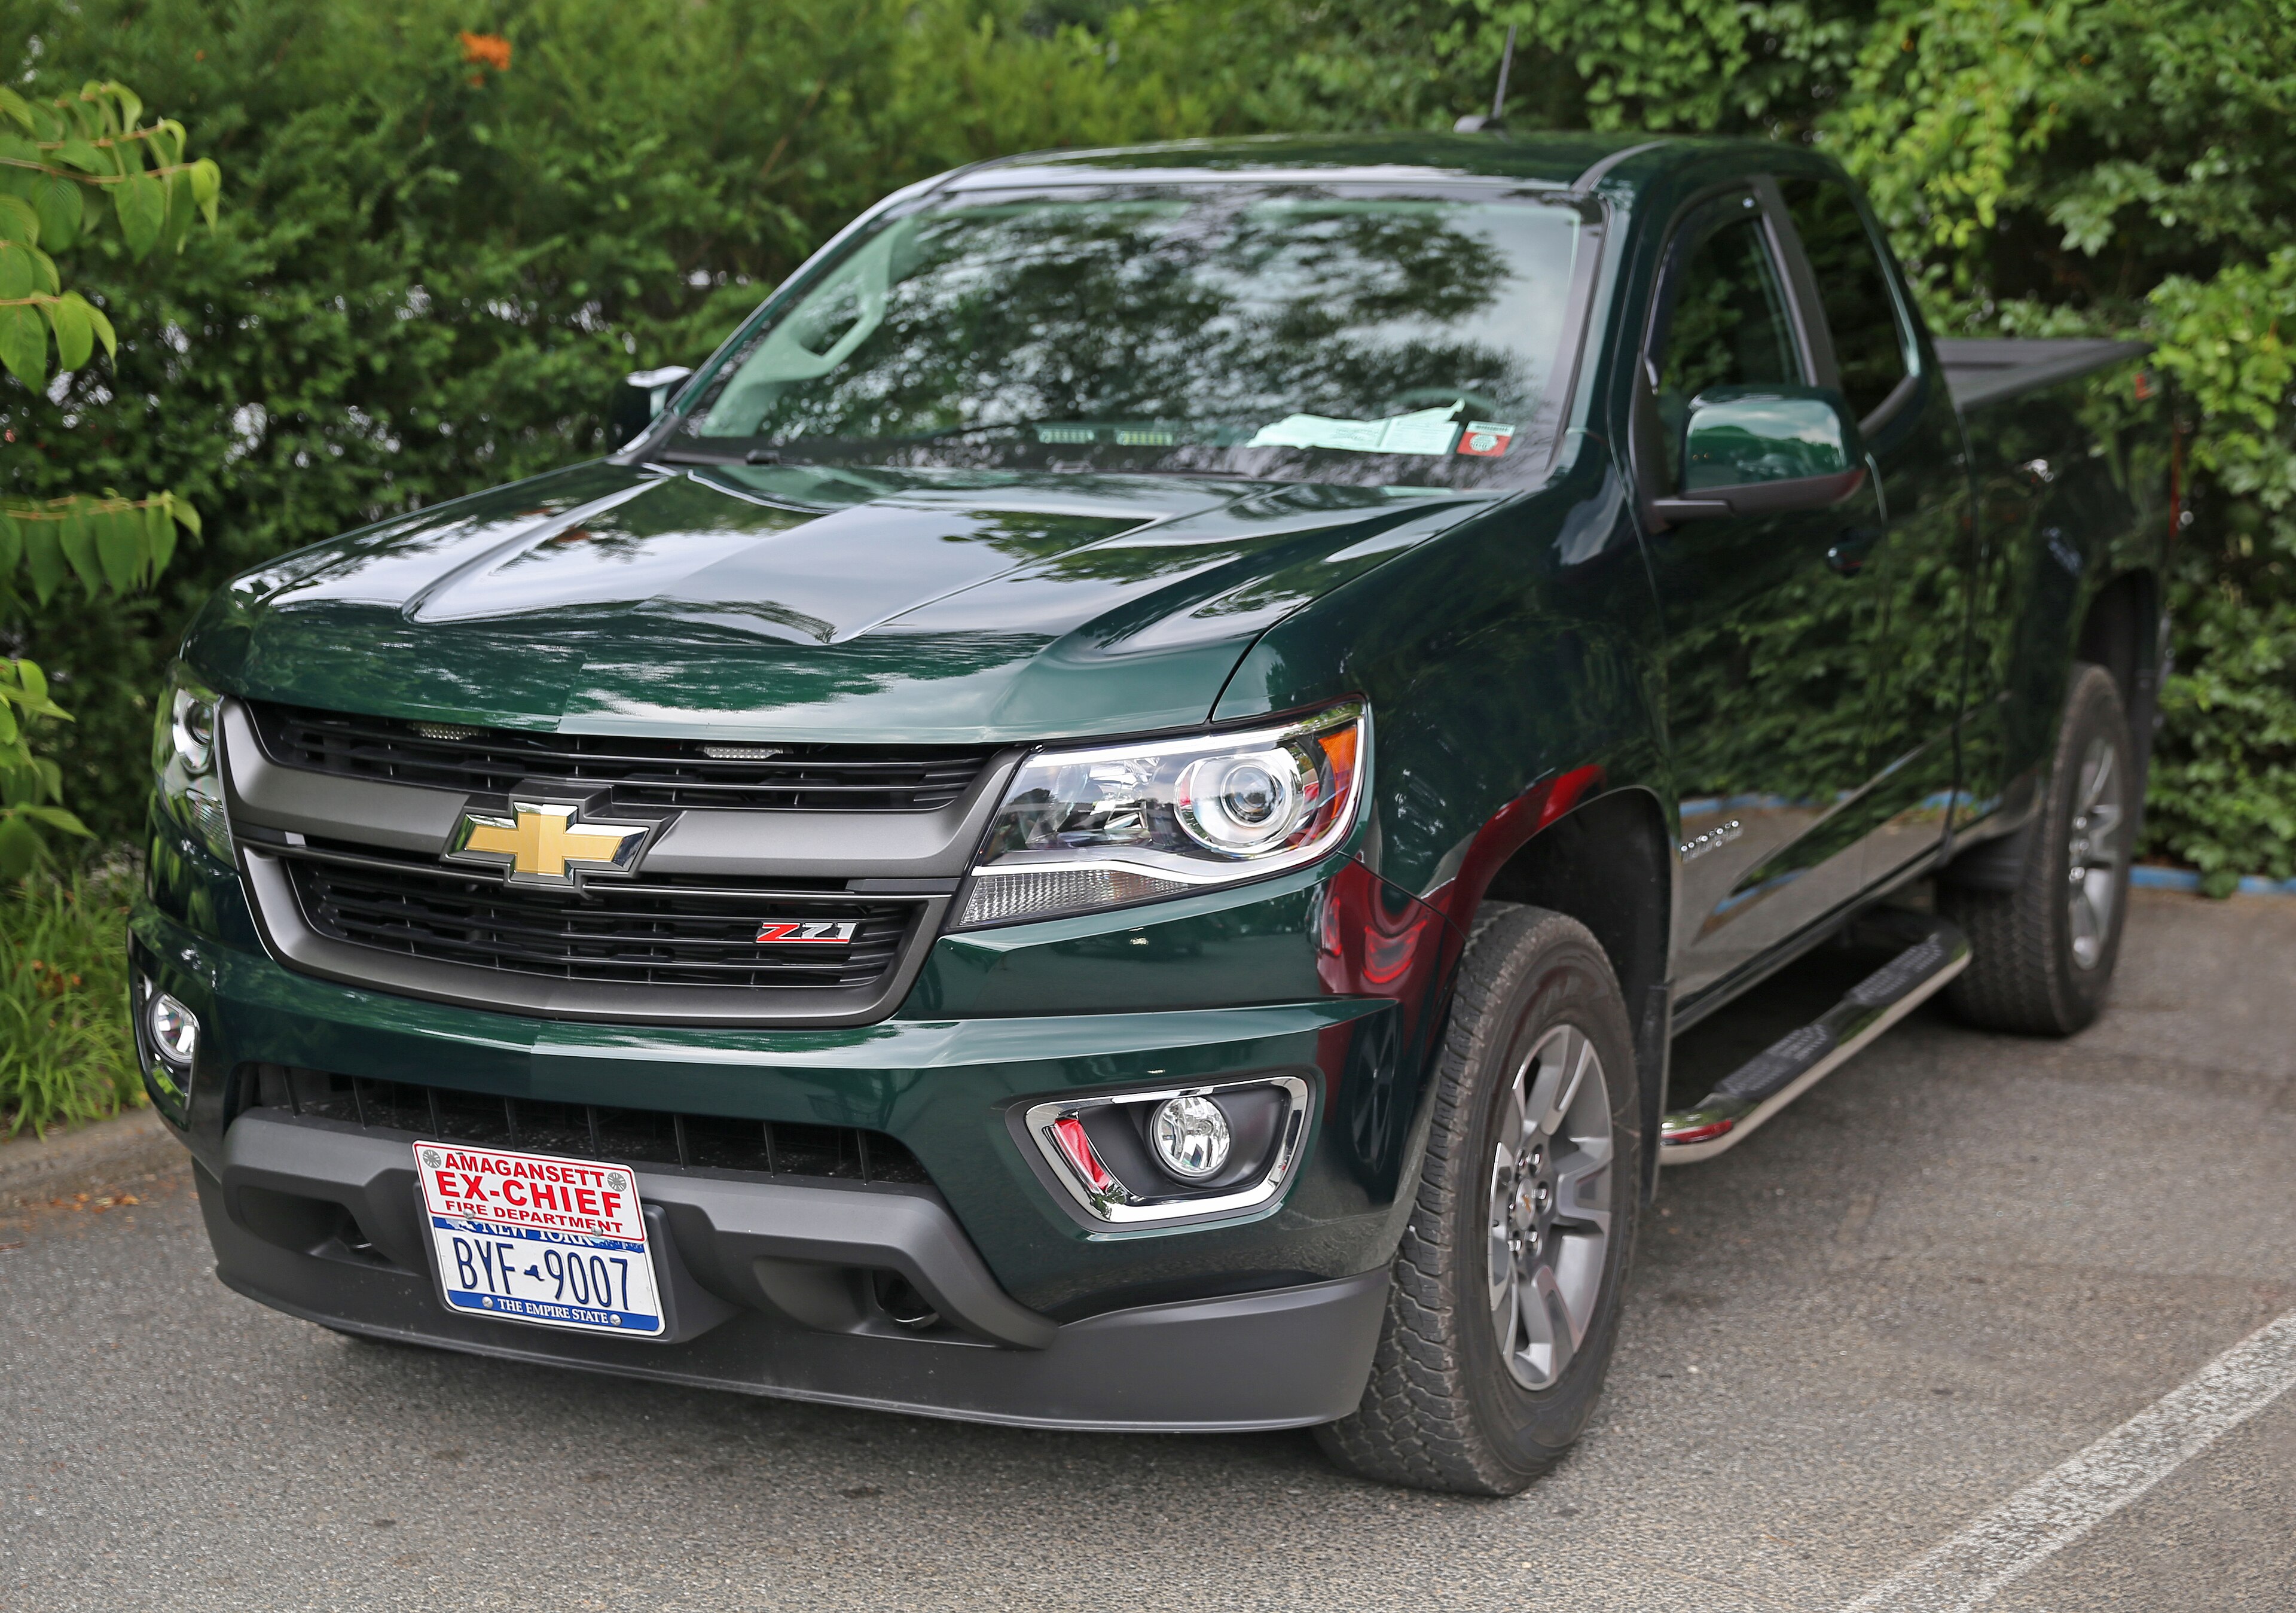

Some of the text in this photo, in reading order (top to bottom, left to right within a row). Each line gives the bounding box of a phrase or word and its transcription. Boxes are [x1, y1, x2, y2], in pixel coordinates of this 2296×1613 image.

[756, 922, 857, 944] Z71
[445, 1152, 605, 1188] AMAGANSETT
[435, 1170, 621, 1218] EX-CHIEF
[445, 1200, 623, 1233] FIRE DEPARTMENT
[497, 1298, 609, 1324] THE EMPIRE STATE
